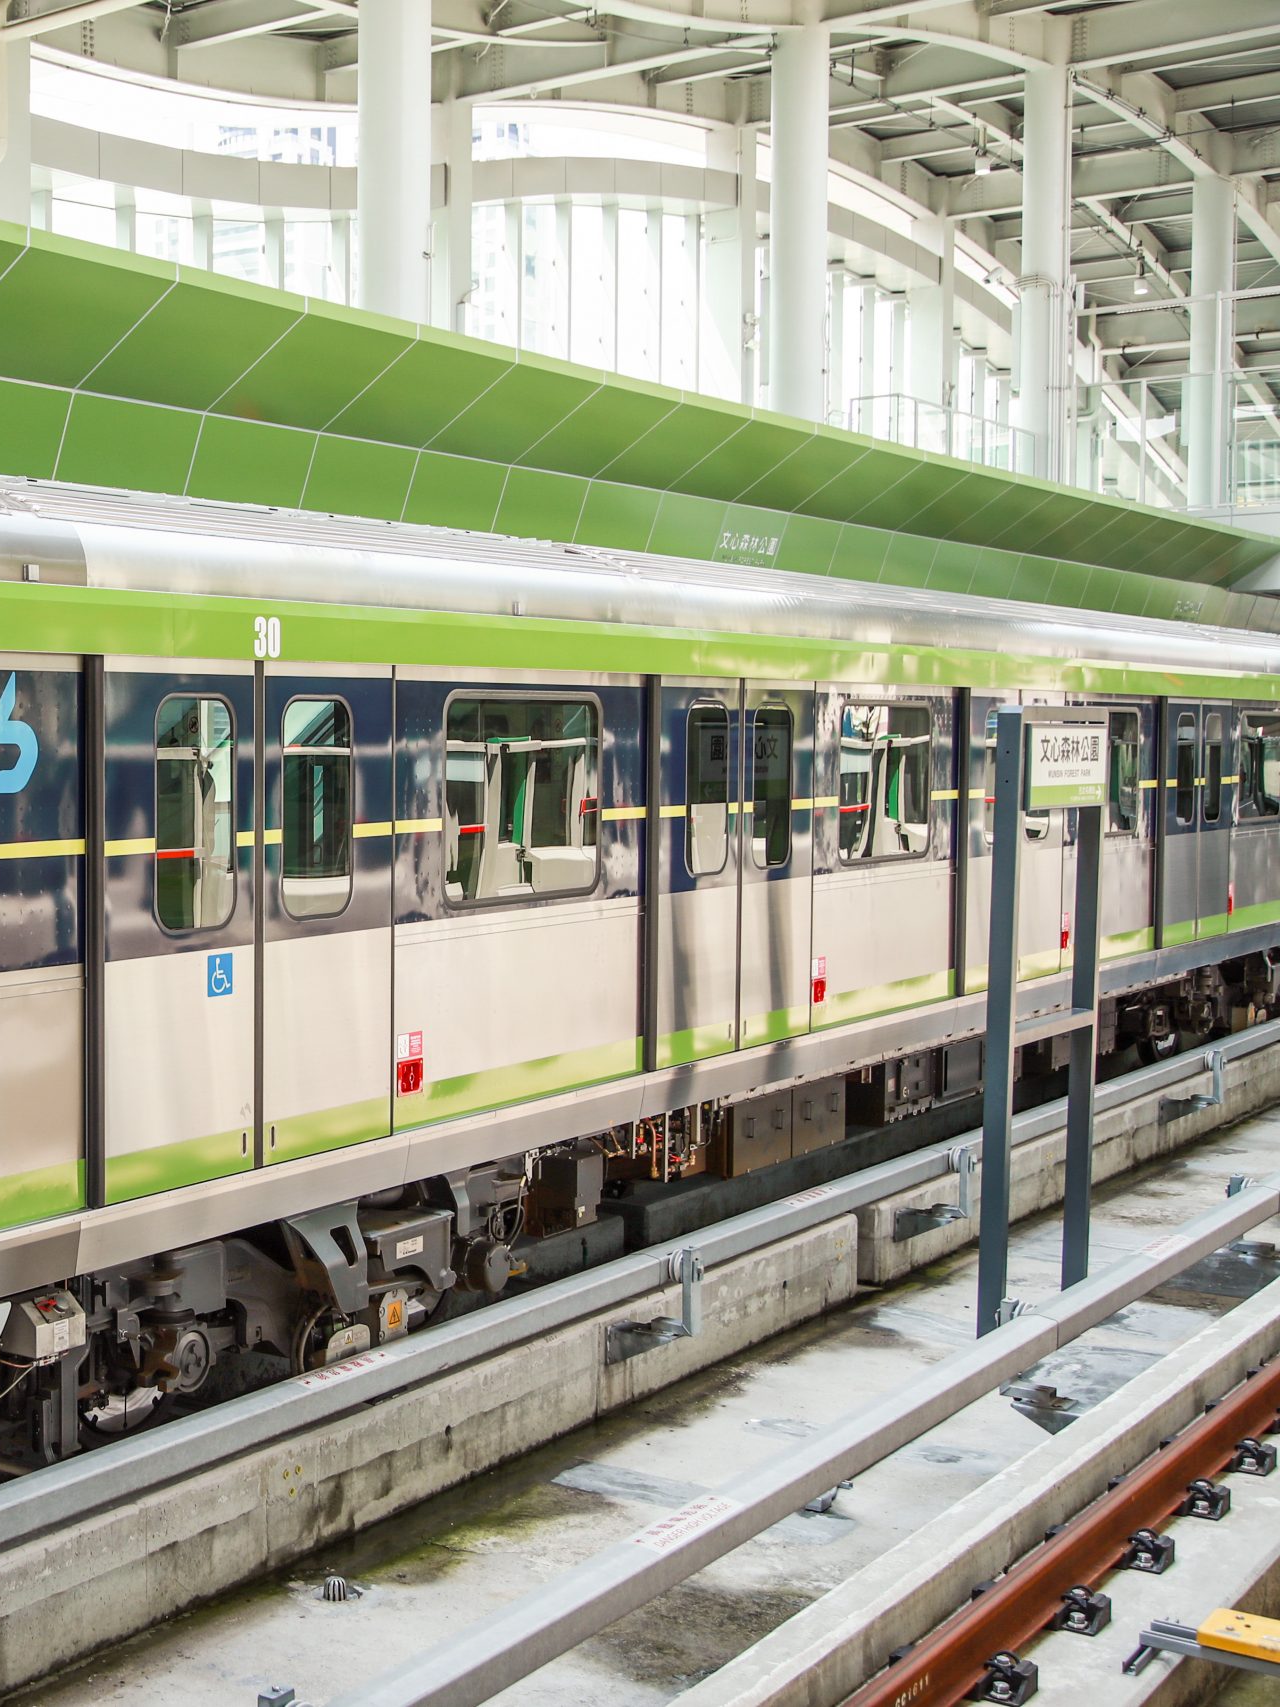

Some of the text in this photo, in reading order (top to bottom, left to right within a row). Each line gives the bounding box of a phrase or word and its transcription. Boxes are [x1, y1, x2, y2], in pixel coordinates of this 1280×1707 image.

[720, 531, 779, 556] 文心森林公園
[254, 616, 280, 658] 30
[1040, 735, 1100, 763] 文心森林公園
[1064, 769, 1079, 778] FOREST
[1080, 768, 1091, 777] PARK
